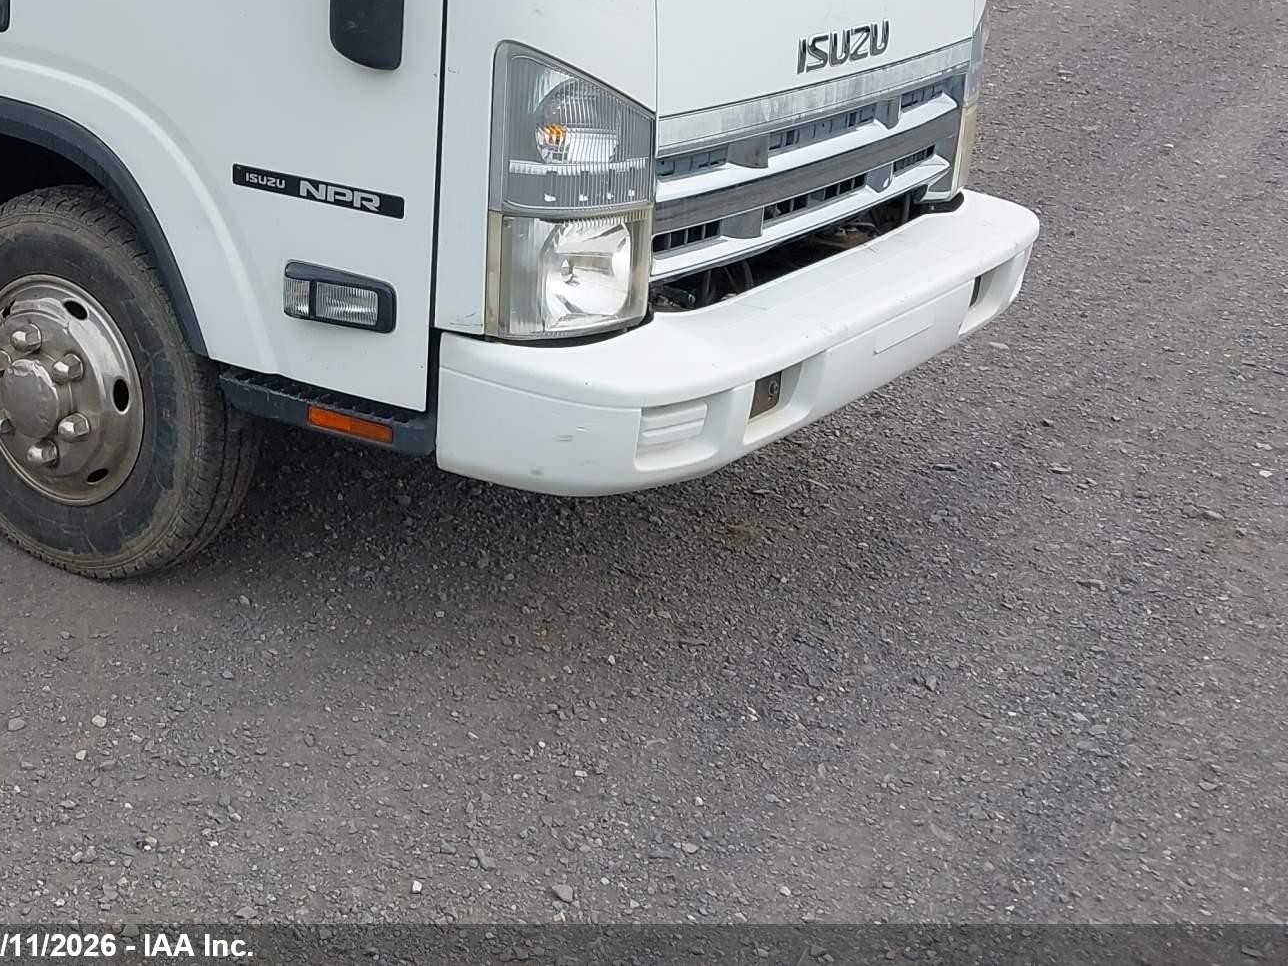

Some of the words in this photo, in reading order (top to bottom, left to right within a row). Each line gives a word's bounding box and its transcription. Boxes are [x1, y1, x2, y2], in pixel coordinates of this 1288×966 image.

[797, 19, 889, 75] ISUZU
[245, 171, 286, 189] ISUZU
[299, 179, 380, 212] NPR
